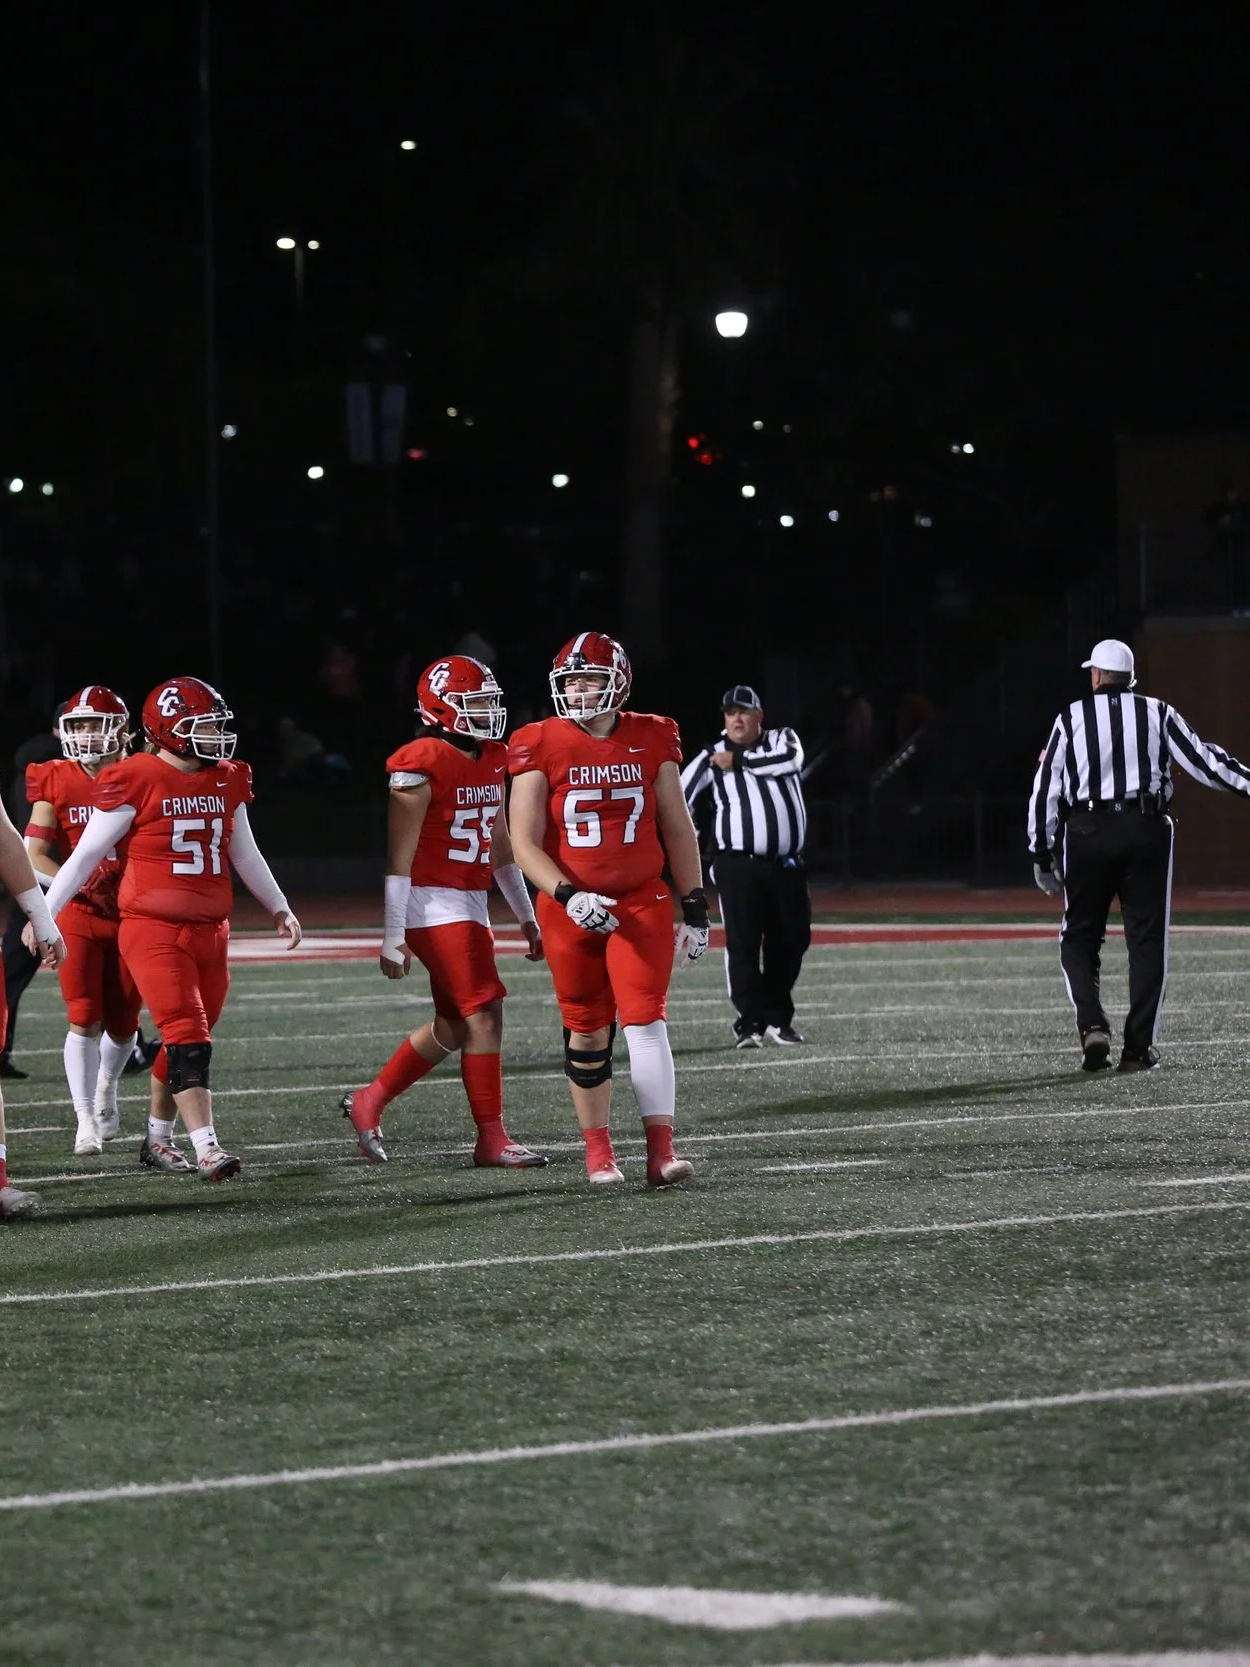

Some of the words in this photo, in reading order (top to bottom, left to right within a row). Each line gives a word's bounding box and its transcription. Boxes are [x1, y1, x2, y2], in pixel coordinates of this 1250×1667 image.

[569, 763, 643, 785] CRIMSON
[456, 784, 501, 804] CRIMSON
[162, 795, 226, 816] CRIMSON
[563, 785, 645, 847] 67
[171, 817, 224, 875] 51
